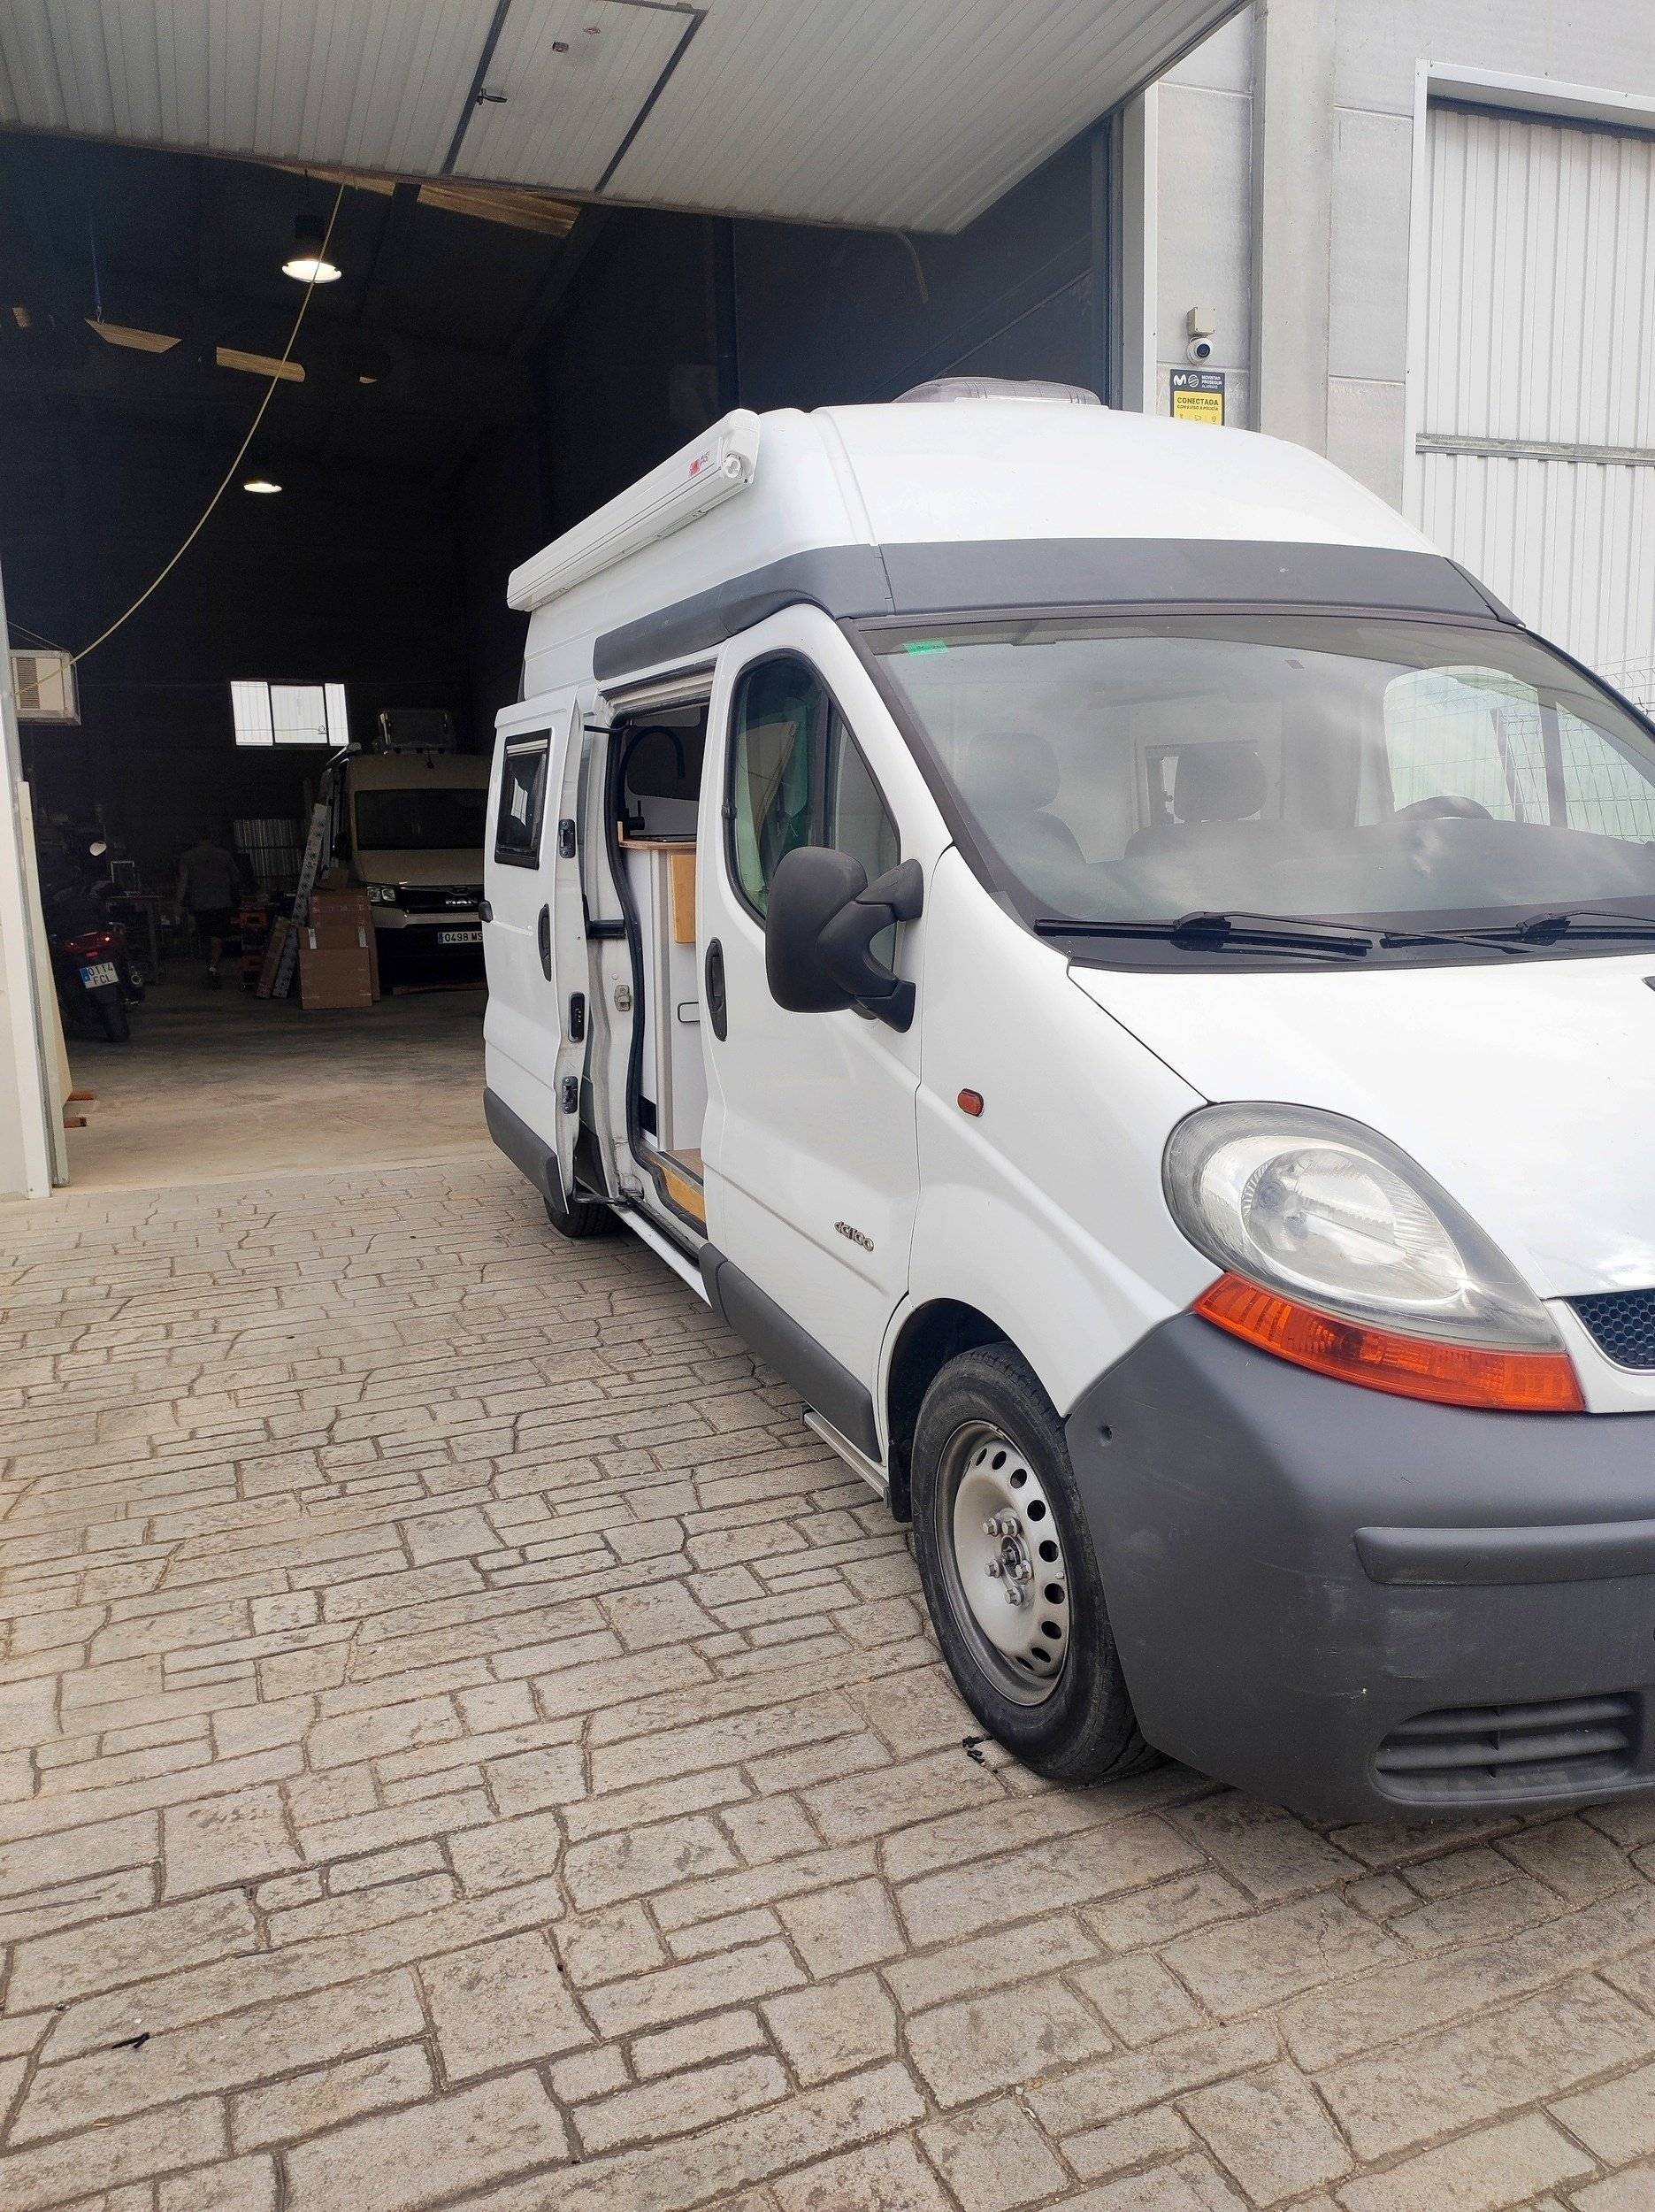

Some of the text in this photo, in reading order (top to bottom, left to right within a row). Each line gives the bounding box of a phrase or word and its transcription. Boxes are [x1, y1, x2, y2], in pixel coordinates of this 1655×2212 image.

[1176, 396, 1219, 406] CONECTADA
[444, 933, 469, 942] 0498
[88, 963, 114, 976] 0114
[93, 973, 113, 985] FCL
